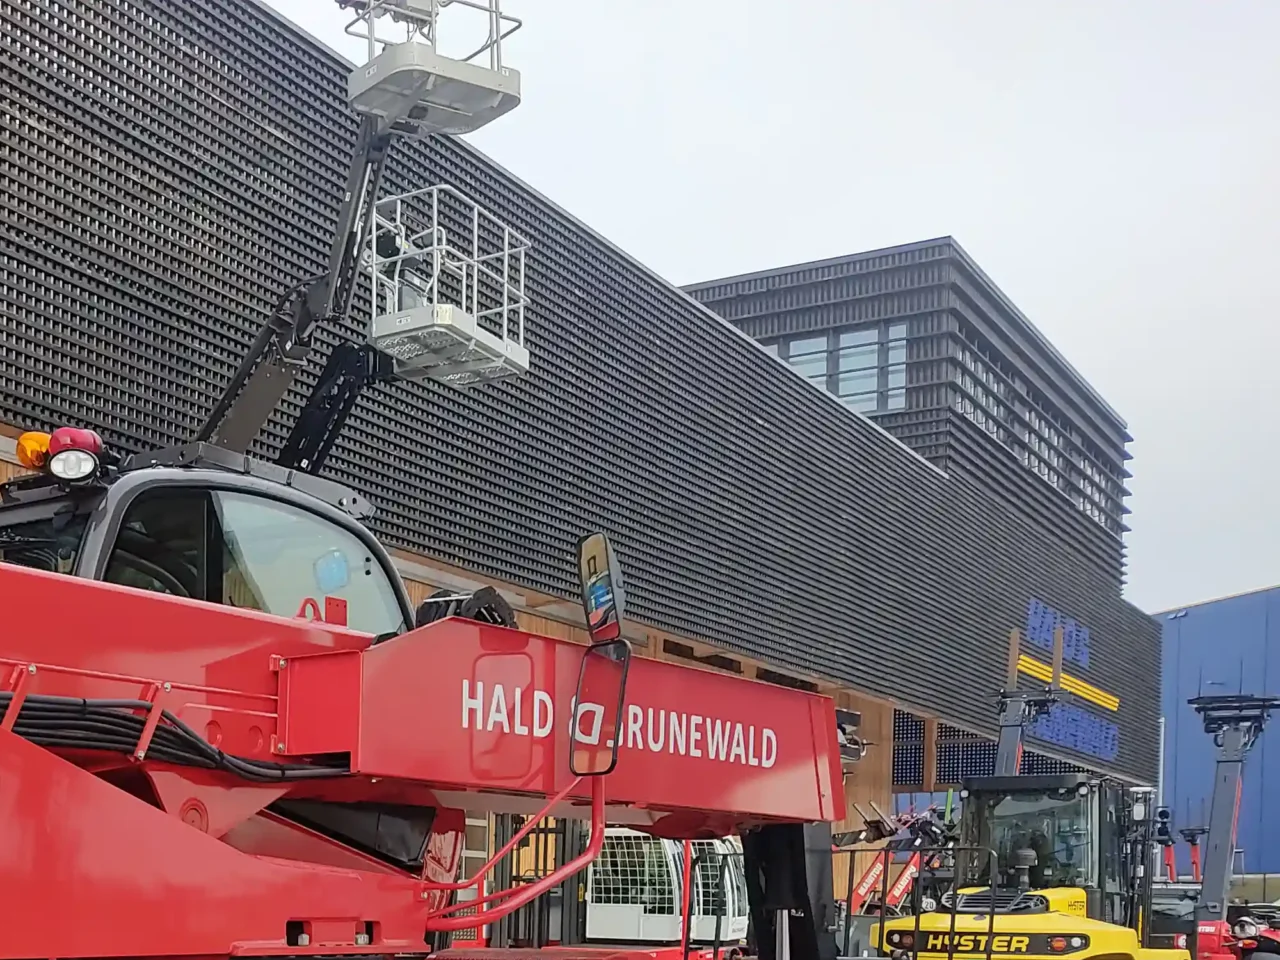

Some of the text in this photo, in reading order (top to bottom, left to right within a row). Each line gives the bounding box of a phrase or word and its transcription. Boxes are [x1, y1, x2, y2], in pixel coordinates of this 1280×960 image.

[461, 678, 555, 739] HALD
[618, 703, 778, 769] RUNEWALD
[924, 900, 934, 910] 20
